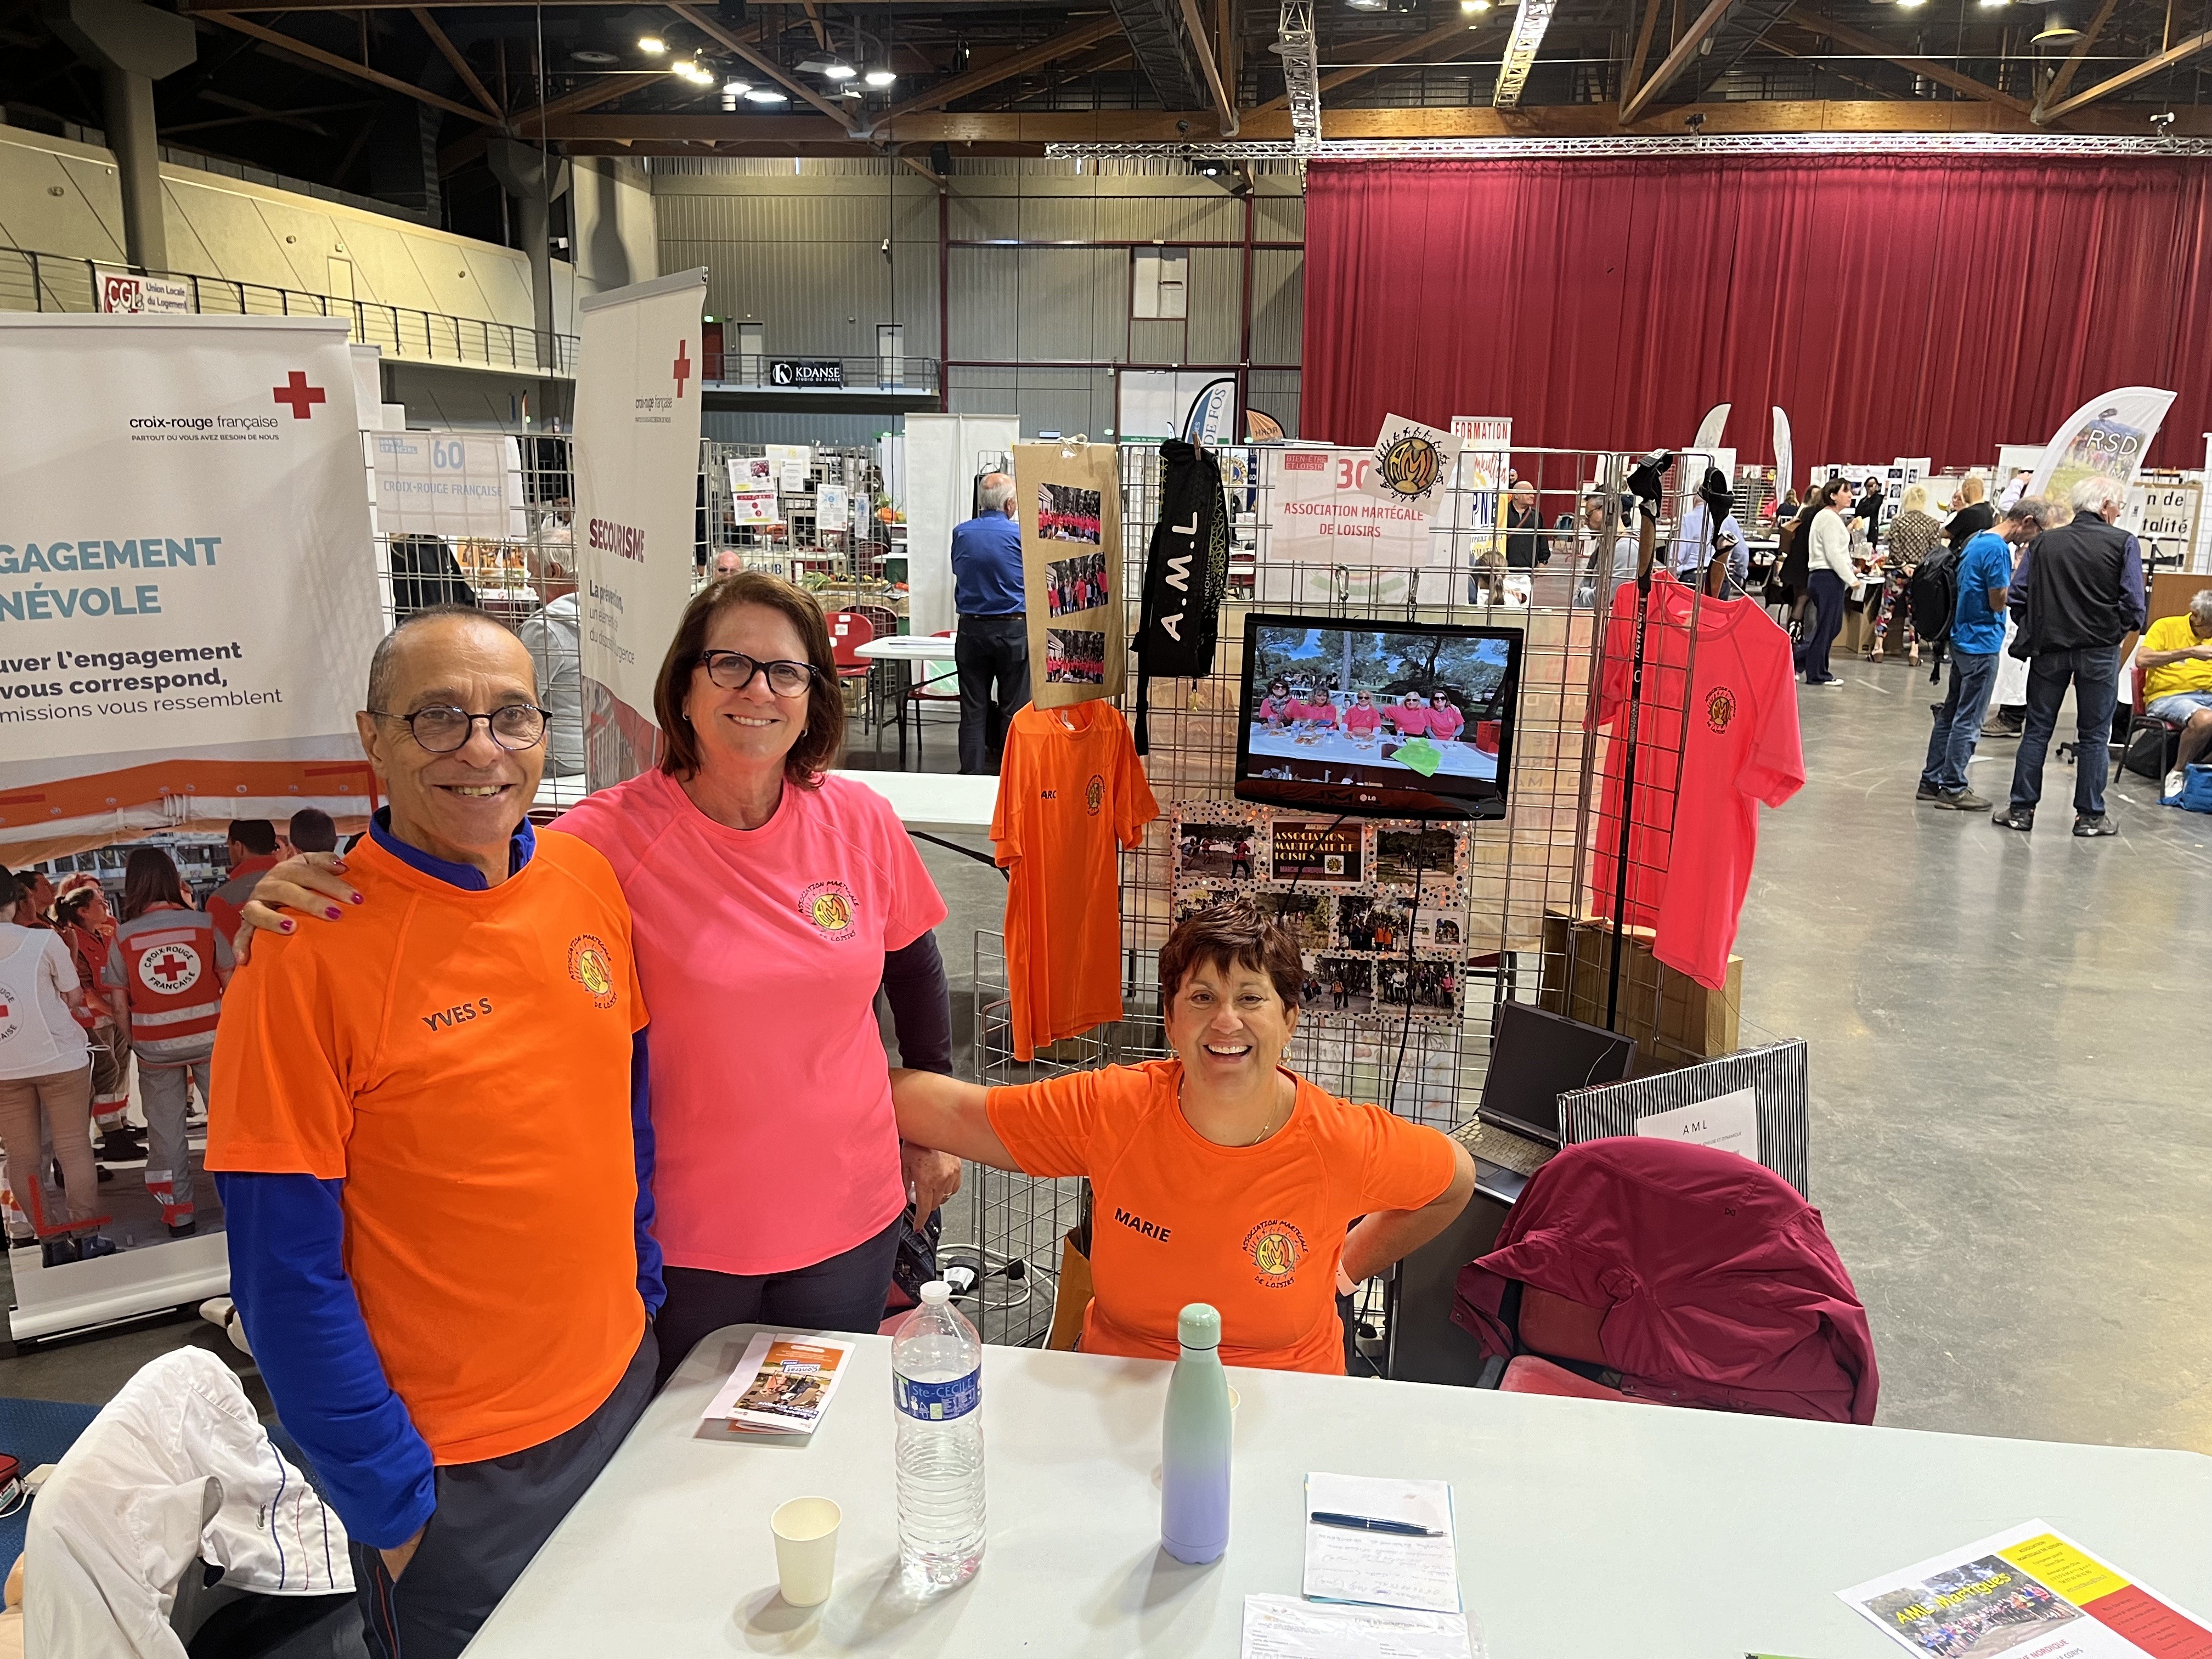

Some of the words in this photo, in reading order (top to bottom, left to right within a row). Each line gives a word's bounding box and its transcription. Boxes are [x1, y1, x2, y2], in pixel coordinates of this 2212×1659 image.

[146, 282, 165, 294] Union
[166, 285, 185, 296] Locale
[148, 296, 155, 306] du
[157, 297, 187, 309] Logement
[795, 367, 840, 377] KDANSE
[1208, 388, 1227, 420] FOS
[129, 416, 213, 430] croix-rouge
[217, 415, 278, 431] française
[1455, 422, 1508, 439] FORMATION
[1204, 425, 1217, 445] DE
[2086, 429, 2138, 455] RSD
[433, 441, 464, 470] 60
[1286, 455, 1328, 463] BIEN-ÊTRE
[384, 481, 448, 494] CROIX-ROUGE
[452, 484, 502, 498] FRANÇAISE
[2163, 491, 2184, 506] de
[1284, 503, 1358, 517] ASSOCIATION
[1362, 505, 1424, 521] MARTÉGALE
[589, 518, 645, 563] SECOURISME
[1319, 524, 1334, 536] DE
[1337, 524, 1381, 538] LOISIRS
[0, 537, 222, 574] GAGEMENT
[590, 579, 599, 598] La
[0, 582, 162, 622] NÉVOLE
[57, 642, 242, 670] l'engagement
[0, 682, 63, 699] vous
[69, 667, 228, 695] correspond,
[0, 703, 92, 723] missions
[98, 701, 148, 715] vous
[154, 689, 283, 712] ressemblent
[1274, 832, 1345, 841] ASSOCIATION
[1340, 844, 1354, 852] DE
[166, 946, 194, 960] ROUGE
[421, 1003, 476, 1031] YVES
[479, 998, 493, 1015] S
[1114, 1207, 1171, 1243] MARIE
[1242, 1220, 1278, 1251] ASSOCIATION
[1255, 1276, 1265, 1284] DE
[912, 1378, 974, 1398] Ste-CECILE
[1896, 1603, 1936, 1625] AML
[1933, 1572, 2012, 1609] Martigues
[2030, 1639, 2069, 1658] NORDIQUE
[2064, 1647, 2084, 1658] CORPS
